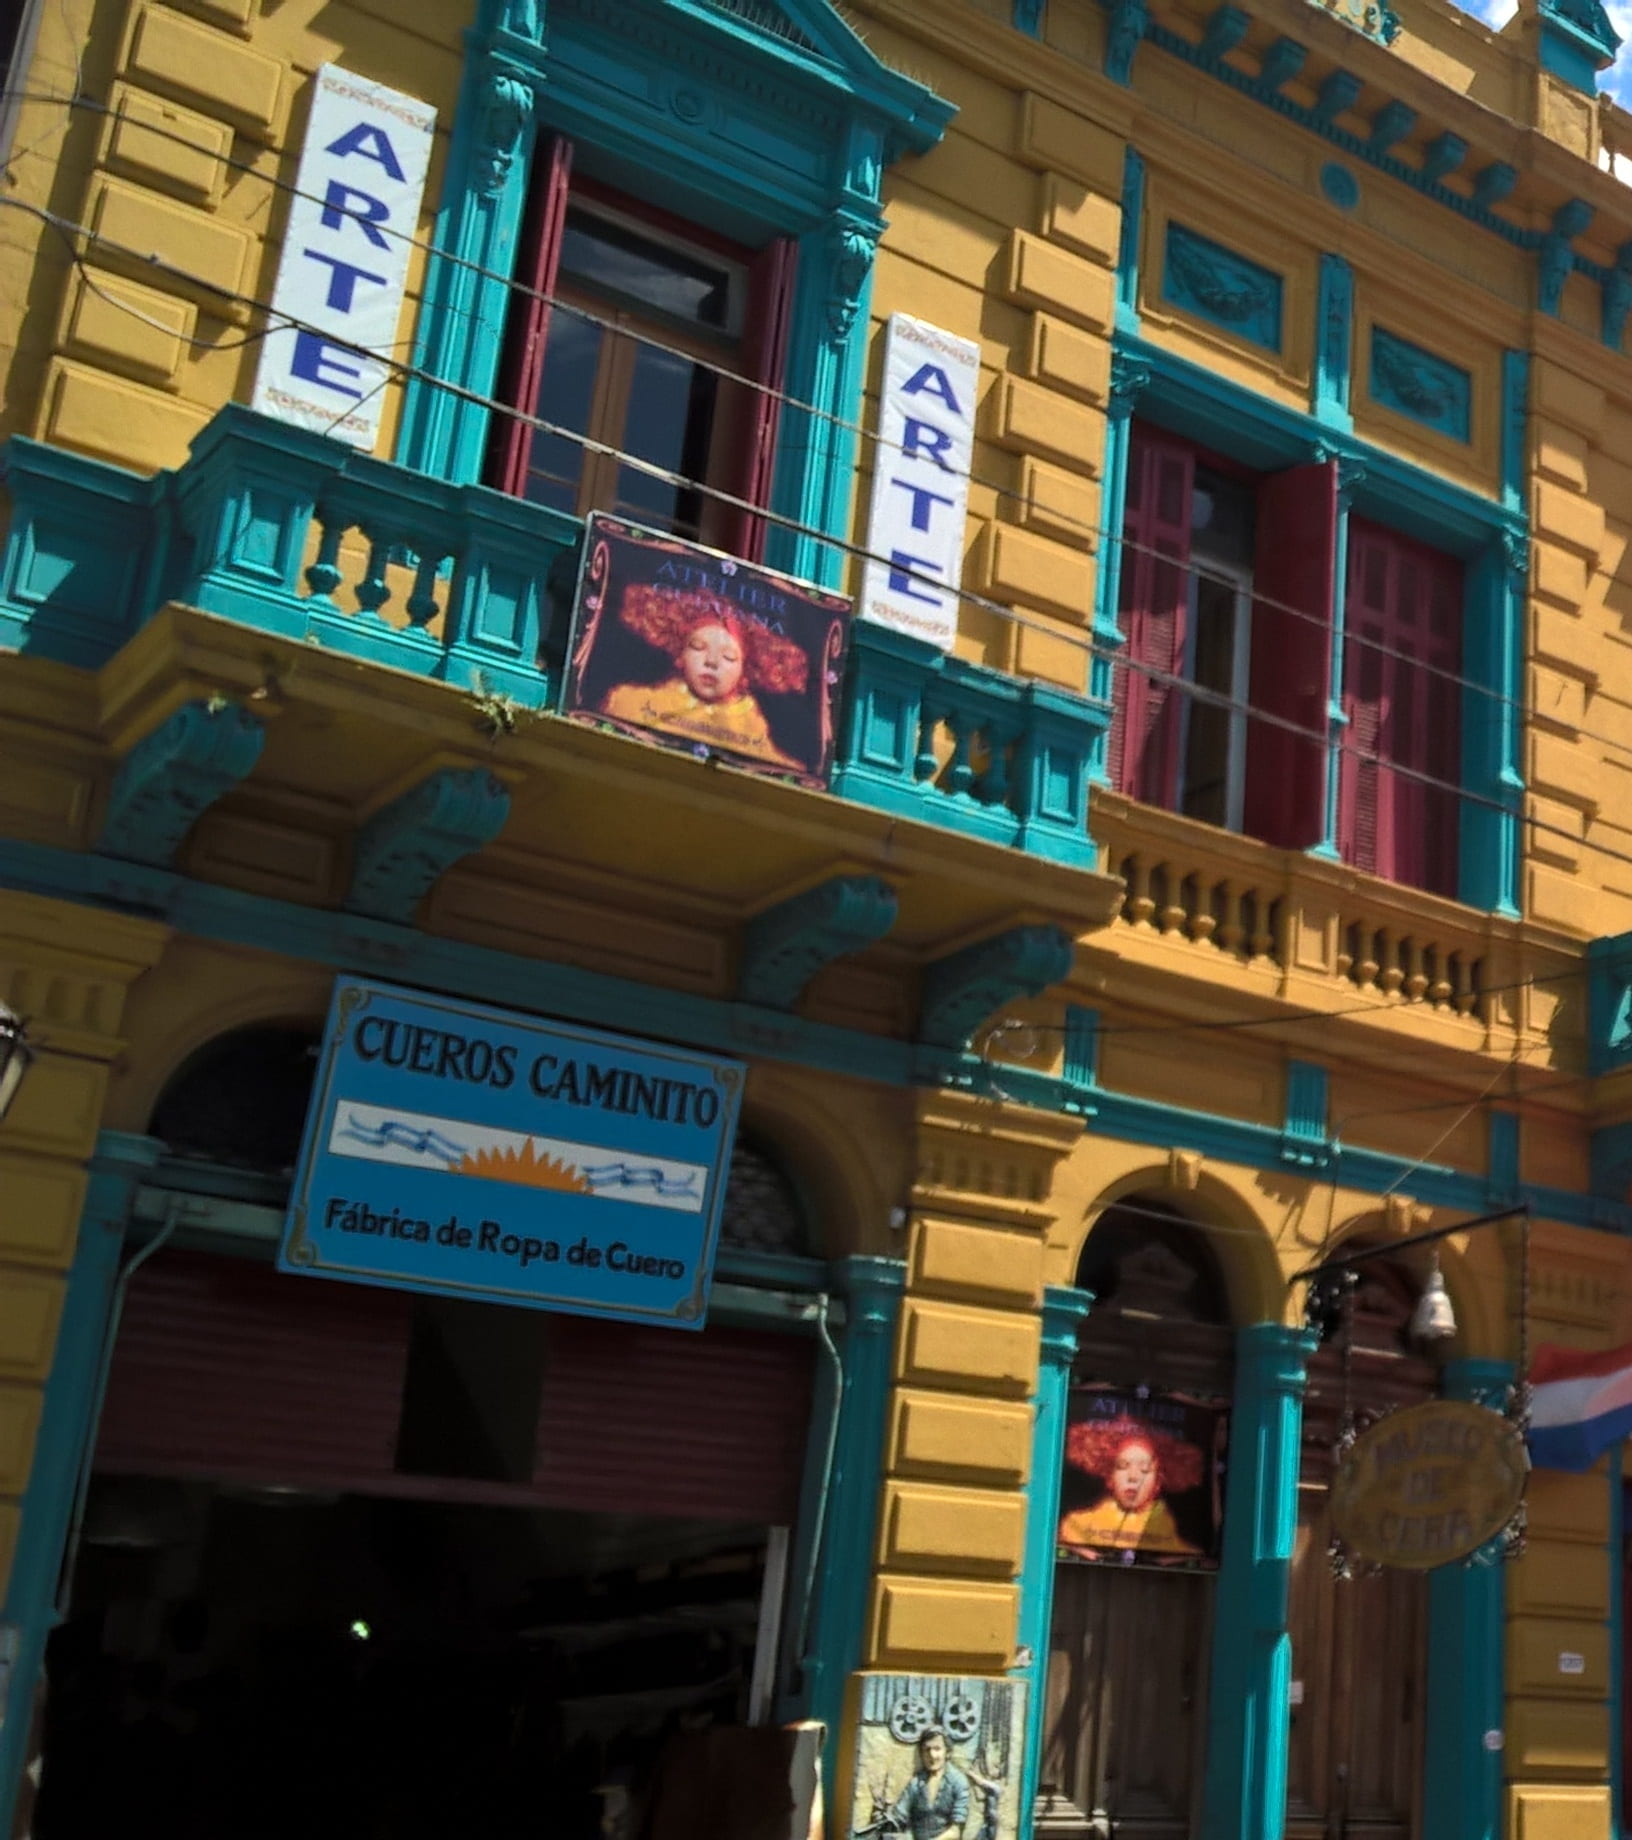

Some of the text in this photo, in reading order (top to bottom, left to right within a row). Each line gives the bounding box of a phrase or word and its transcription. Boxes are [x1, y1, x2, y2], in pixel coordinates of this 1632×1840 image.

[289, 121, 408, 401] ARTE
[888, 361, 961, 607] ARTE
[352, 1014, 720, 1128] CUEROS CAMINITO
[323, 1196, 686, 1281] Fábrica de Ropa de Cuero
